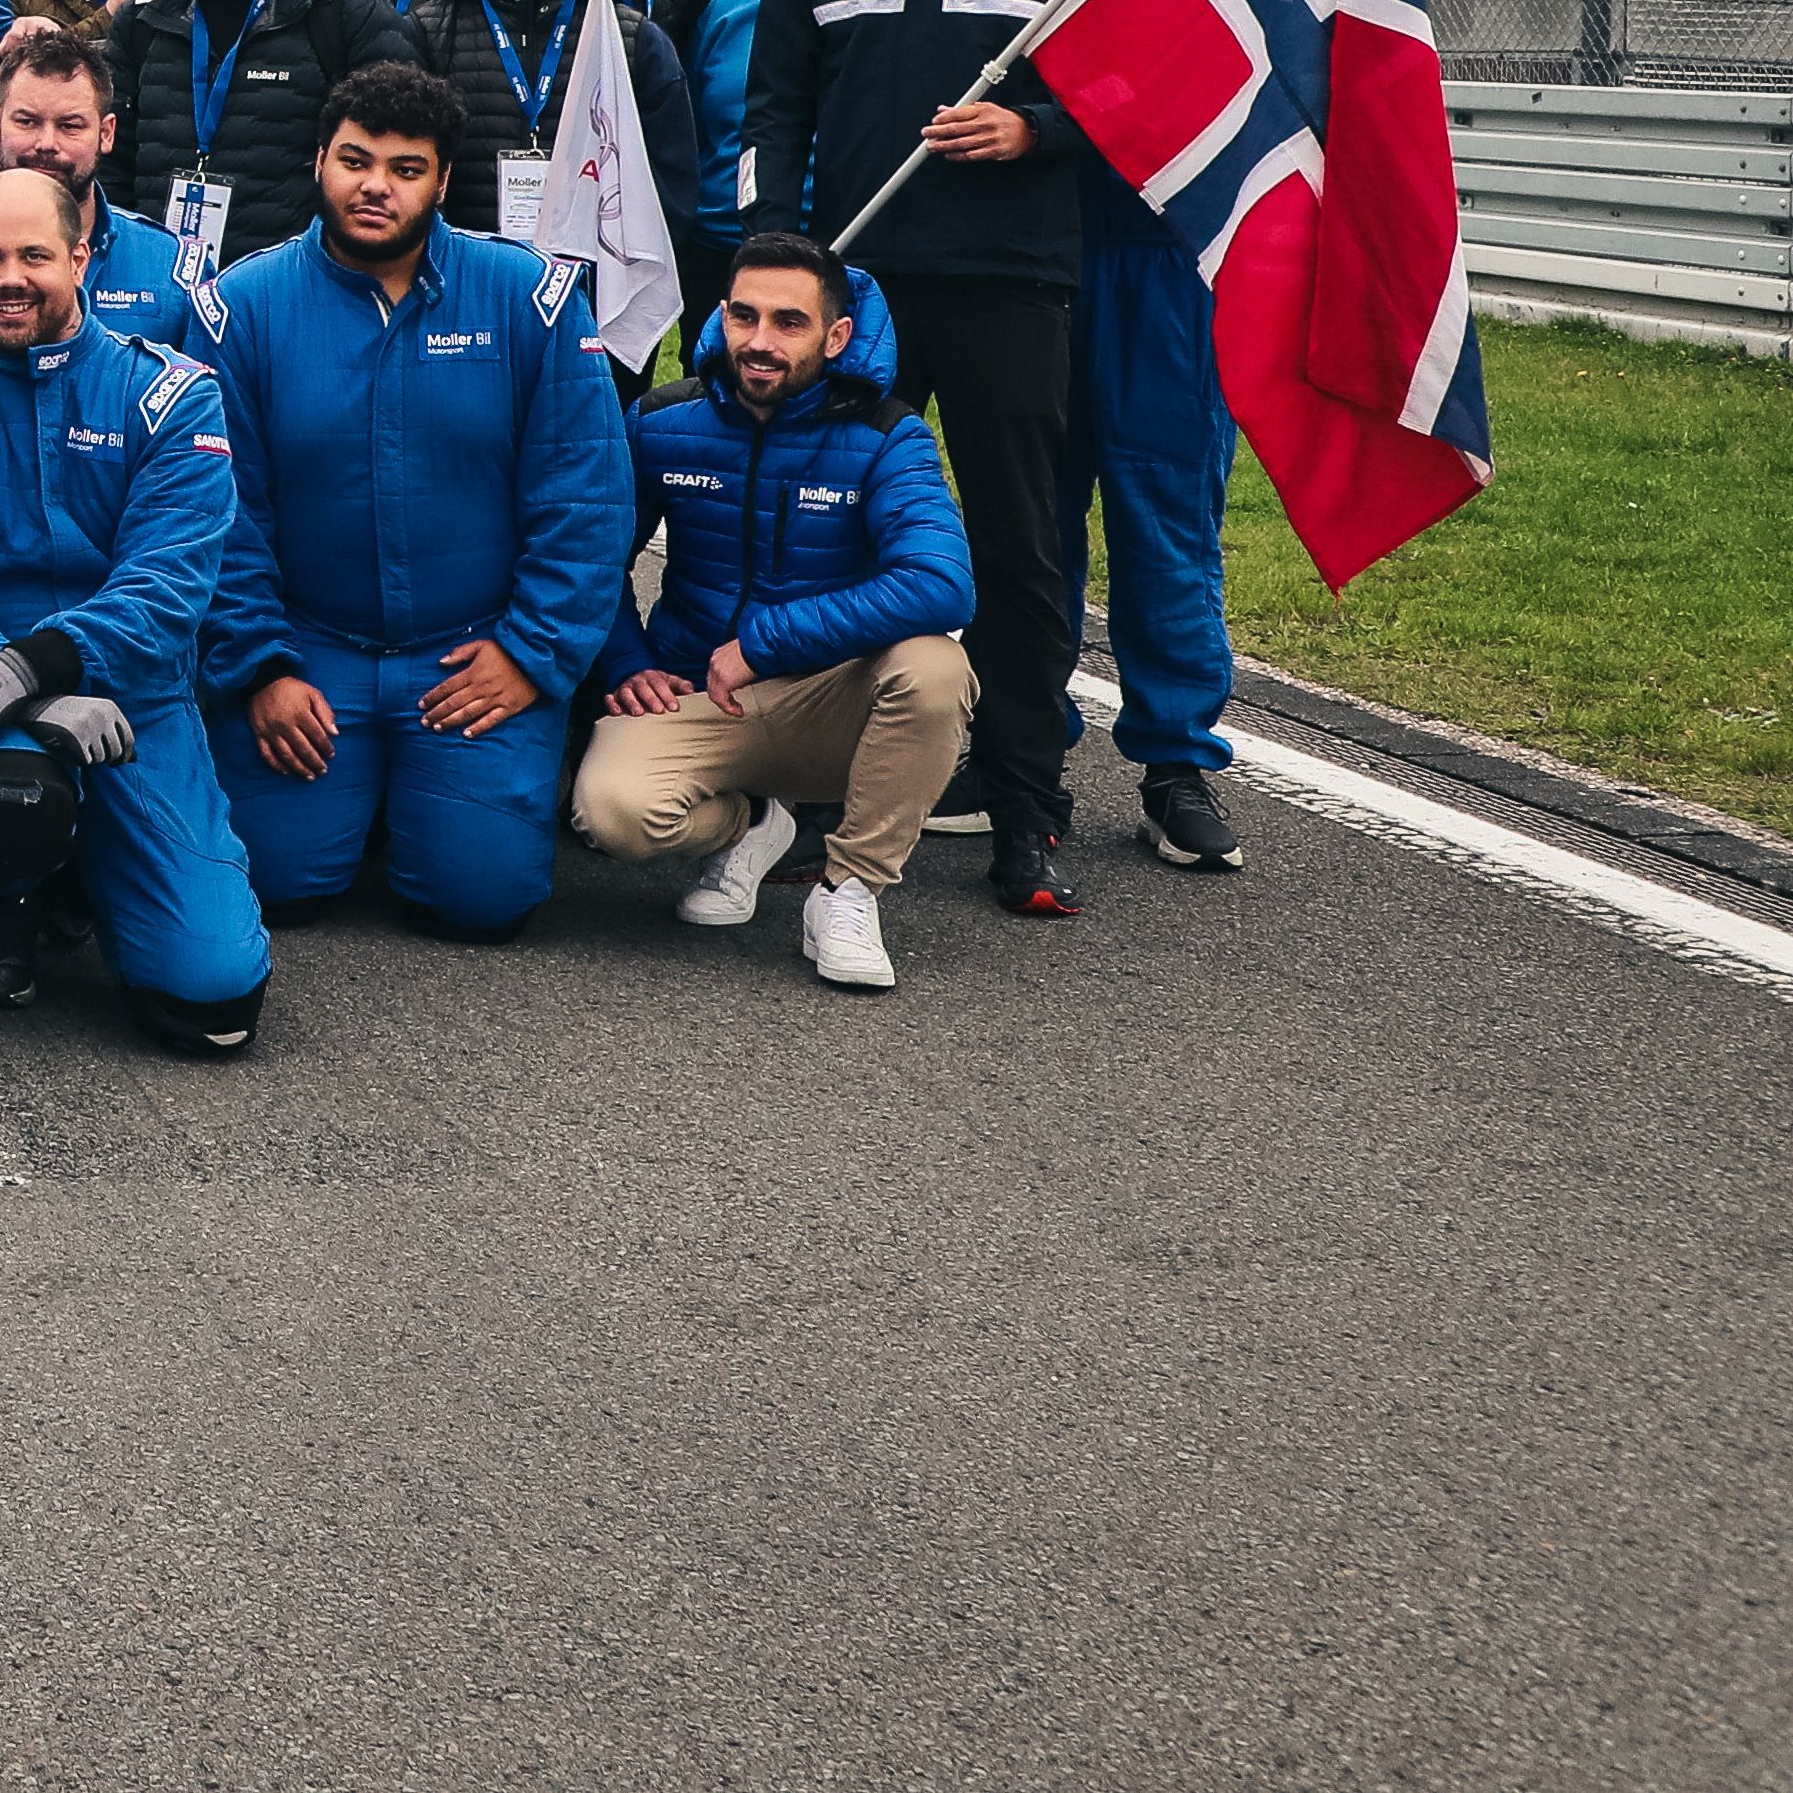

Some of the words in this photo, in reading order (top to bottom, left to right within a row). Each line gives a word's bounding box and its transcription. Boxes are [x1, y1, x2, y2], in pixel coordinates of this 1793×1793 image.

[540, 264, 571, 308] sparco
[476, 331, 491, 345] Bil
[147, 368, 190, 413] sparco
[108, 433, 124, 448] Bil
[662, 472, 710, 488] CRAFT
